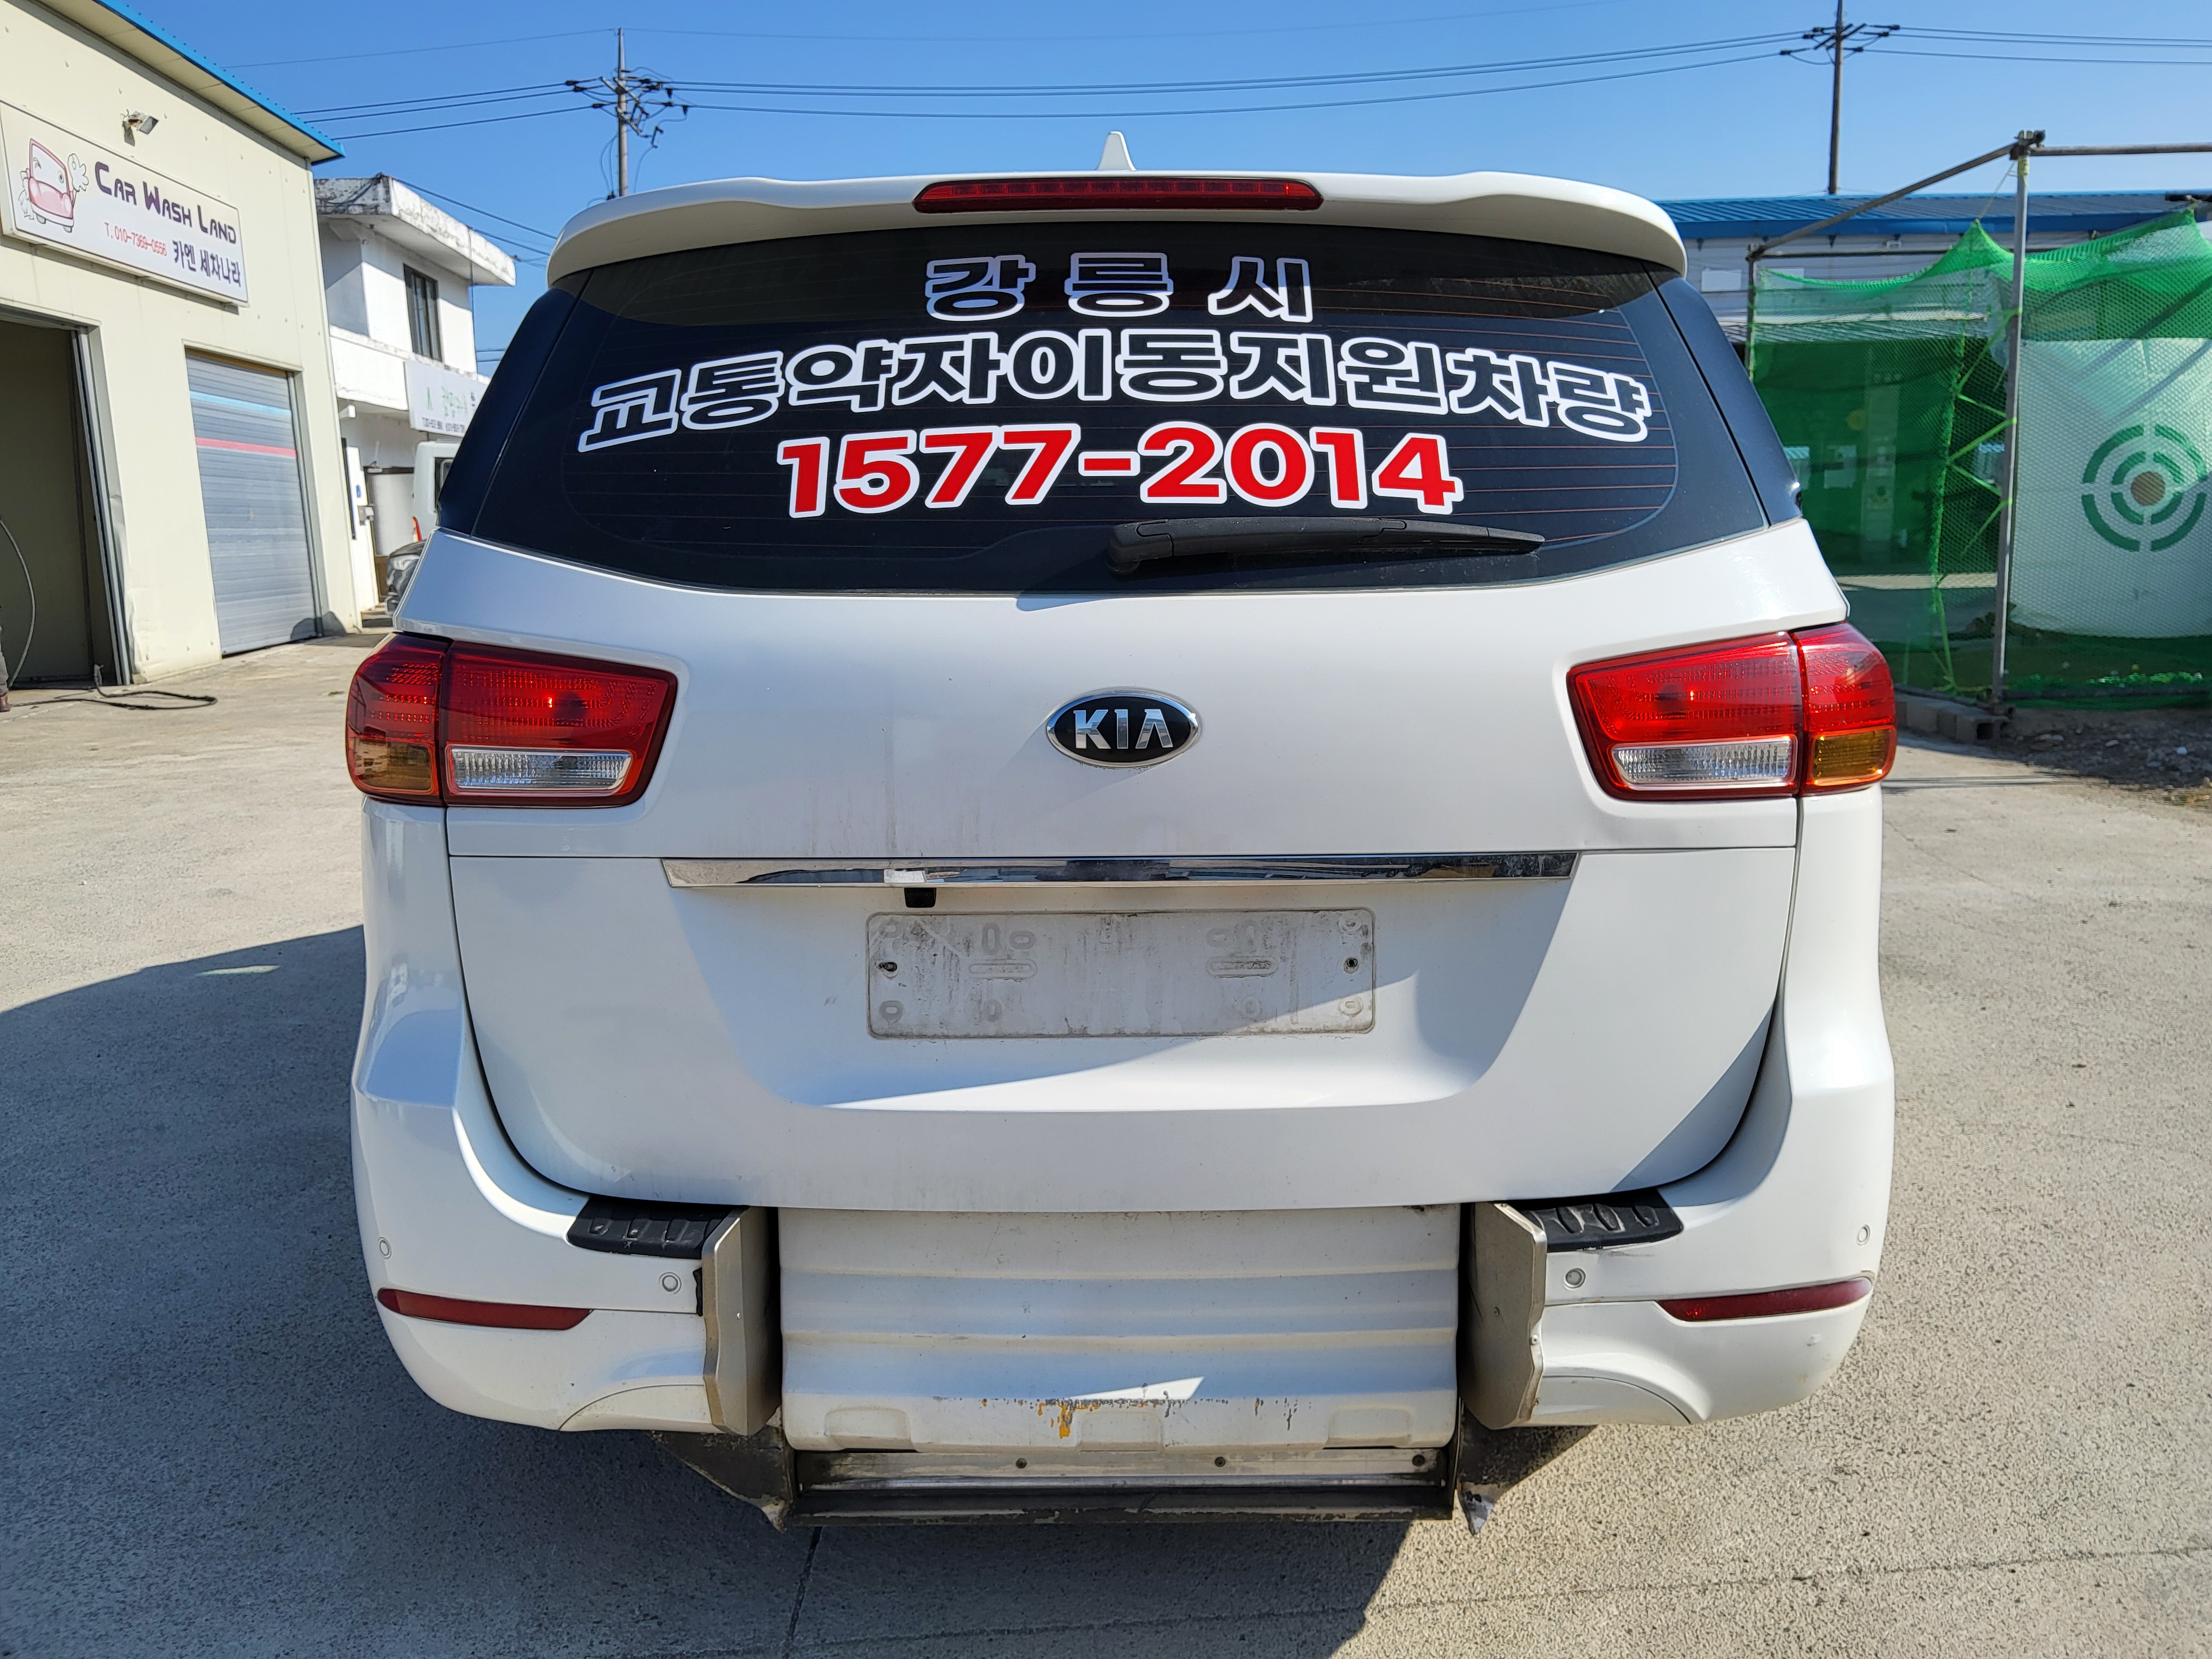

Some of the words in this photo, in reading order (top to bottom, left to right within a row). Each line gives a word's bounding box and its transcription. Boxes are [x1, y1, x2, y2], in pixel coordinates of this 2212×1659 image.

[200, 249, 241, 287] 세차나라
[577, 329, 1652, 453] 교통약자이동지원차량
[777, 421, 1464, 518] 1577-2014
[1073, 709, 1174, 749] KIA
